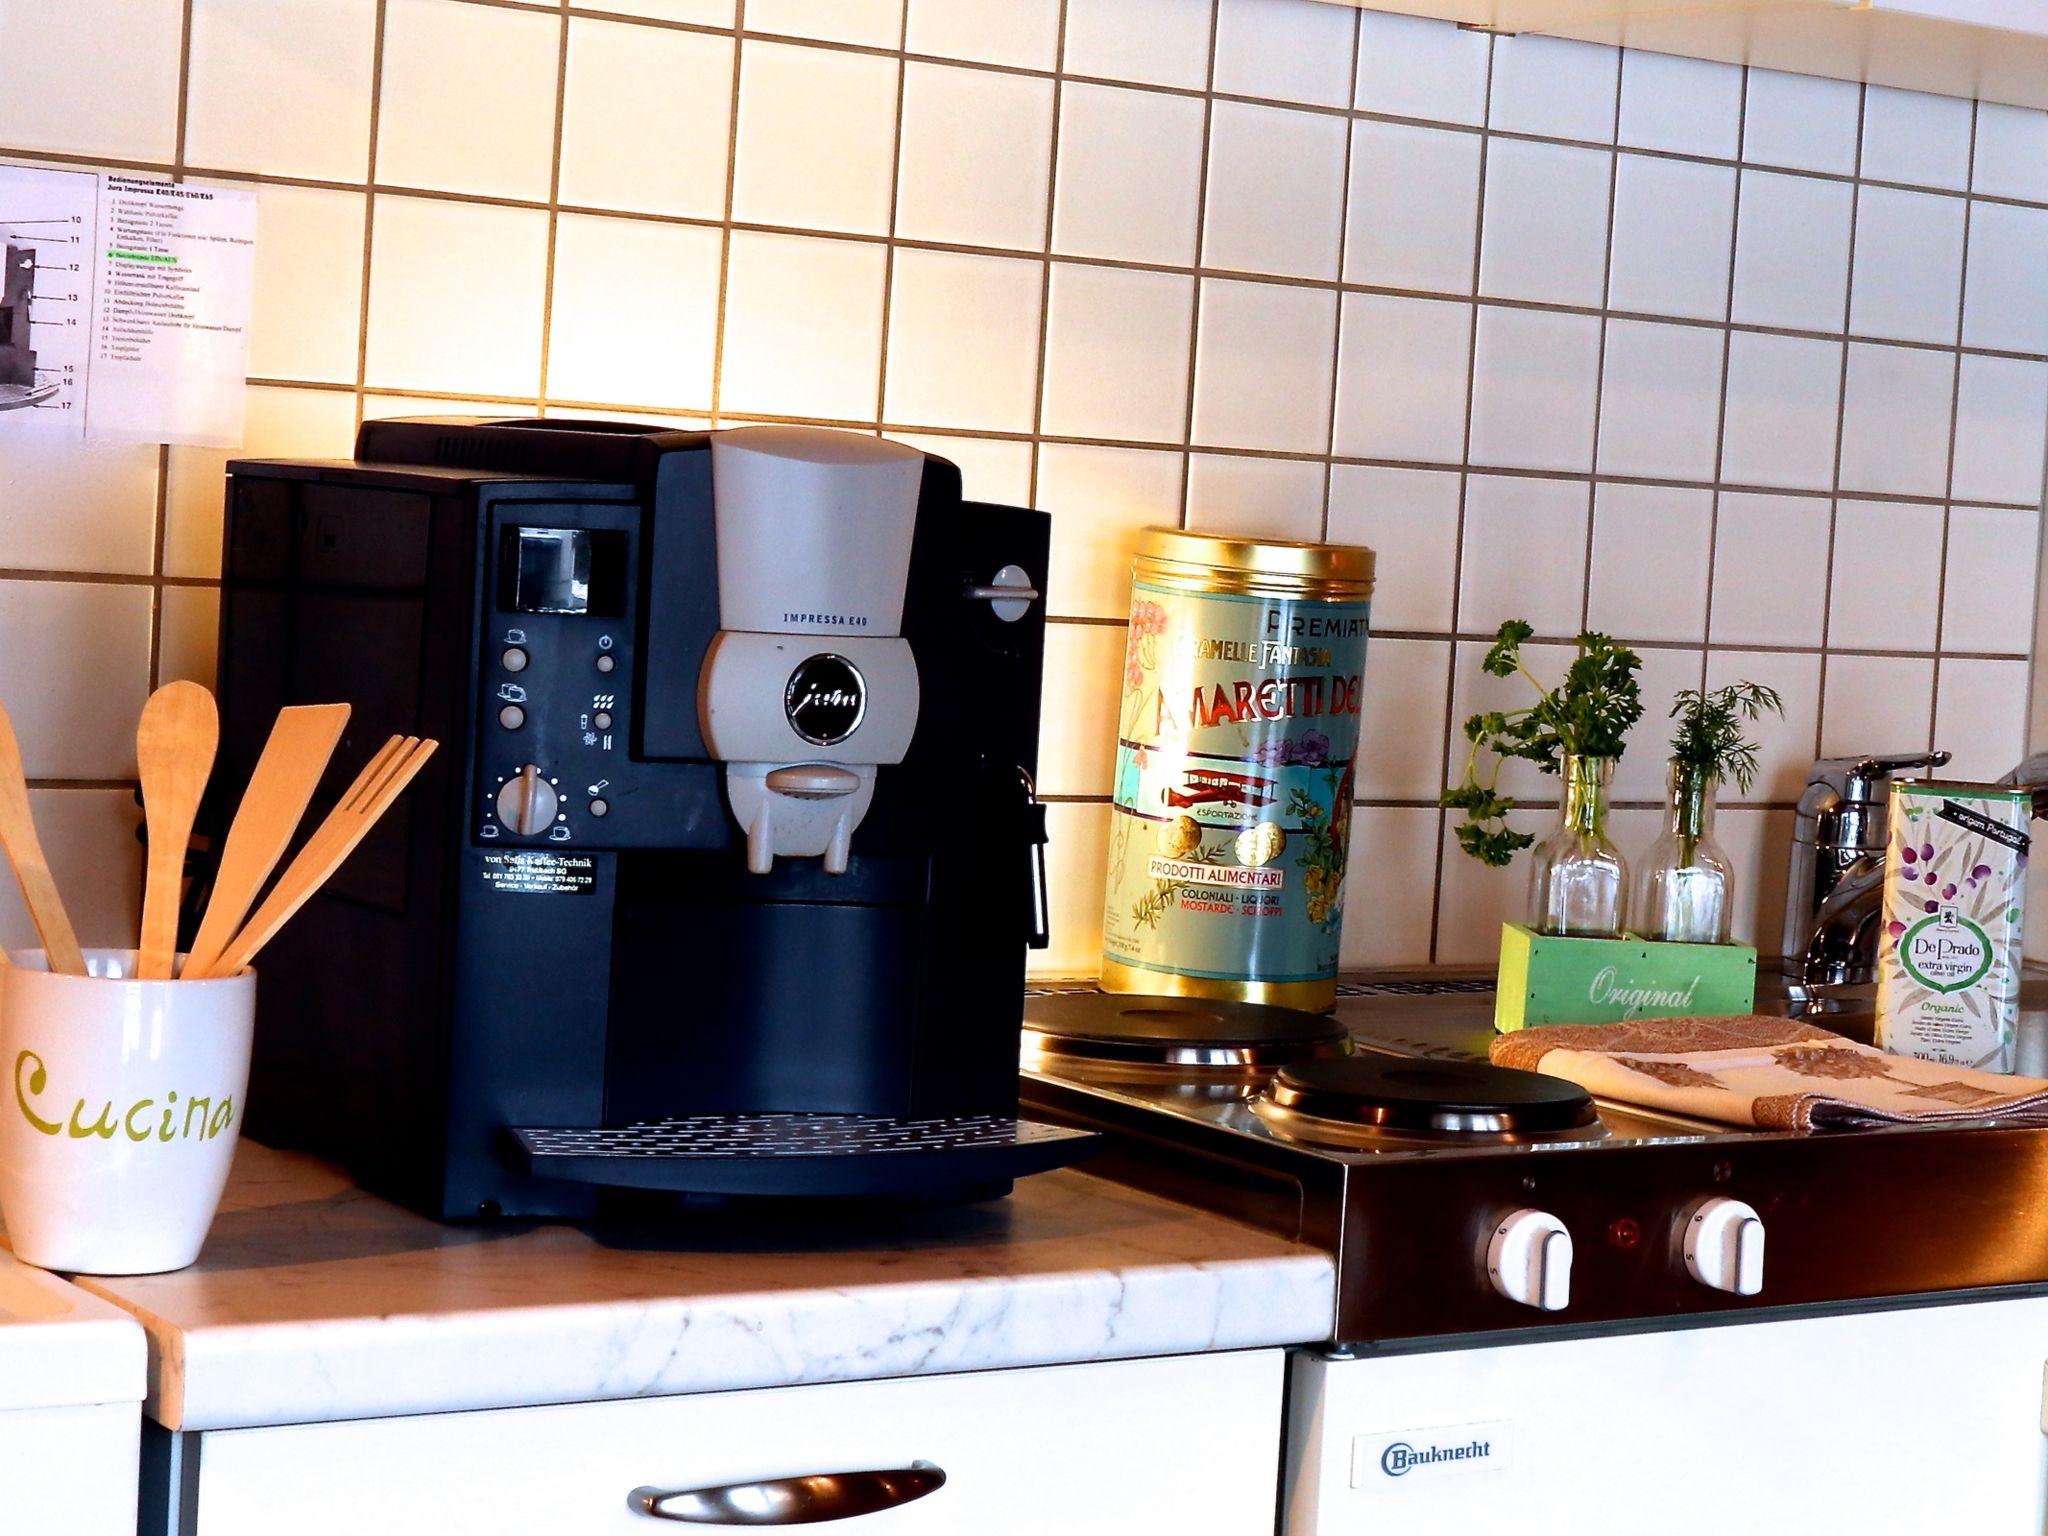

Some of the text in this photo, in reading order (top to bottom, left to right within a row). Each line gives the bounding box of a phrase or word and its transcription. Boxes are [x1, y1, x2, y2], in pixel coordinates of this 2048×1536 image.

[107, 184, 123, 192] Jura
[124, 186, 154, 196] Impressa
[71, 216, 82, 224] 10
[70, 236, 80, 244] 11
[69, 263, 80, 272] 12
[68, 294, 78, 302] 13
[66, 318, 77, 326] 14
[64, 365, 74, 373] 15
[63, 378, 73, 386] 16
[62, 402, 72, 410] 17
[783, 612, 868, 627] IMPRESSA E40
[1267, 609, 1369, 639] PREMIAT
[1155, 674, 1325, 737] AMARETTI
[1986, 823, 2023, 845] Portugal
[484, 855, 502, 864] von
[527, 855, 592, 868] Kaffee-Technik
[1150, 860, 1281, 886] PRODOTTI ALIMENTARI
[1181, 888, 1234, 903] COLONIALI
[1180, 900, 1234, 914] MOSTARDE
[1914, 938, 1981, 960] De Prado
[1918, 960, 1973, 975] extra virgin
[1588, 965, 1701, 1020] Original
[1921, 1001, 1965, 1014] Organic
[14, 1049, 233, 1143] Cucina
[1382, 1440, 1491, 1476] Bauknecht
